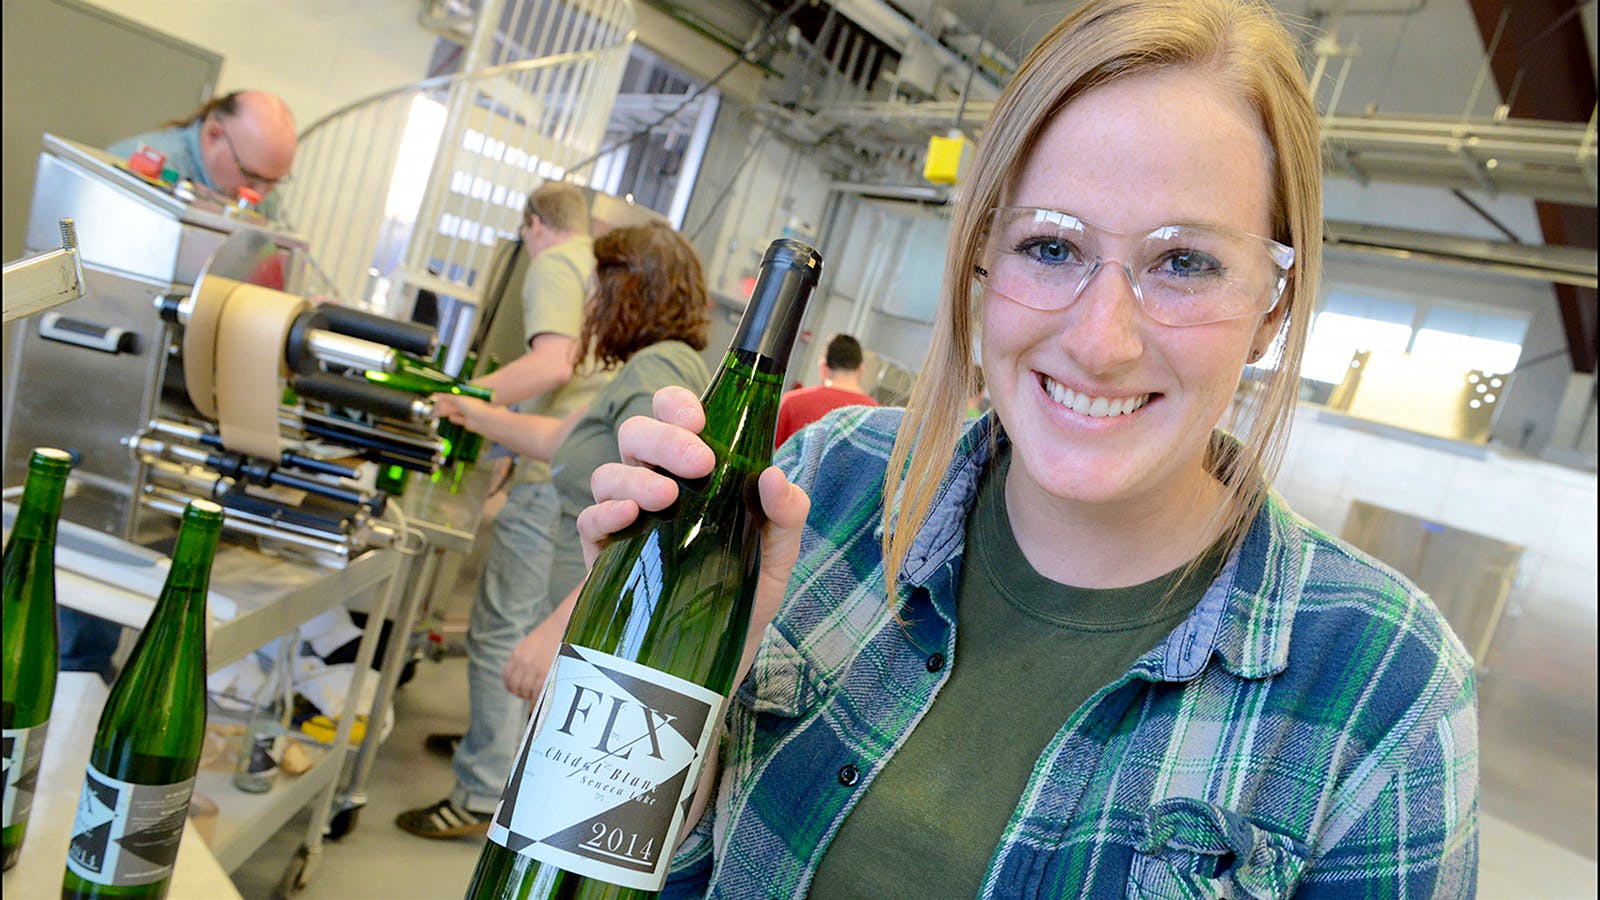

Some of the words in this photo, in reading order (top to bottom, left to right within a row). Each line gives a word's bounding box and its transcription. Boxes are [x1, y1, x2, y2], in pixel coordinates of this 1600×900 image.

[557, 684, 678, 762] FLX
[582, 776, 623, 795] Seneca
[587, 822, 654, 860] 2014
